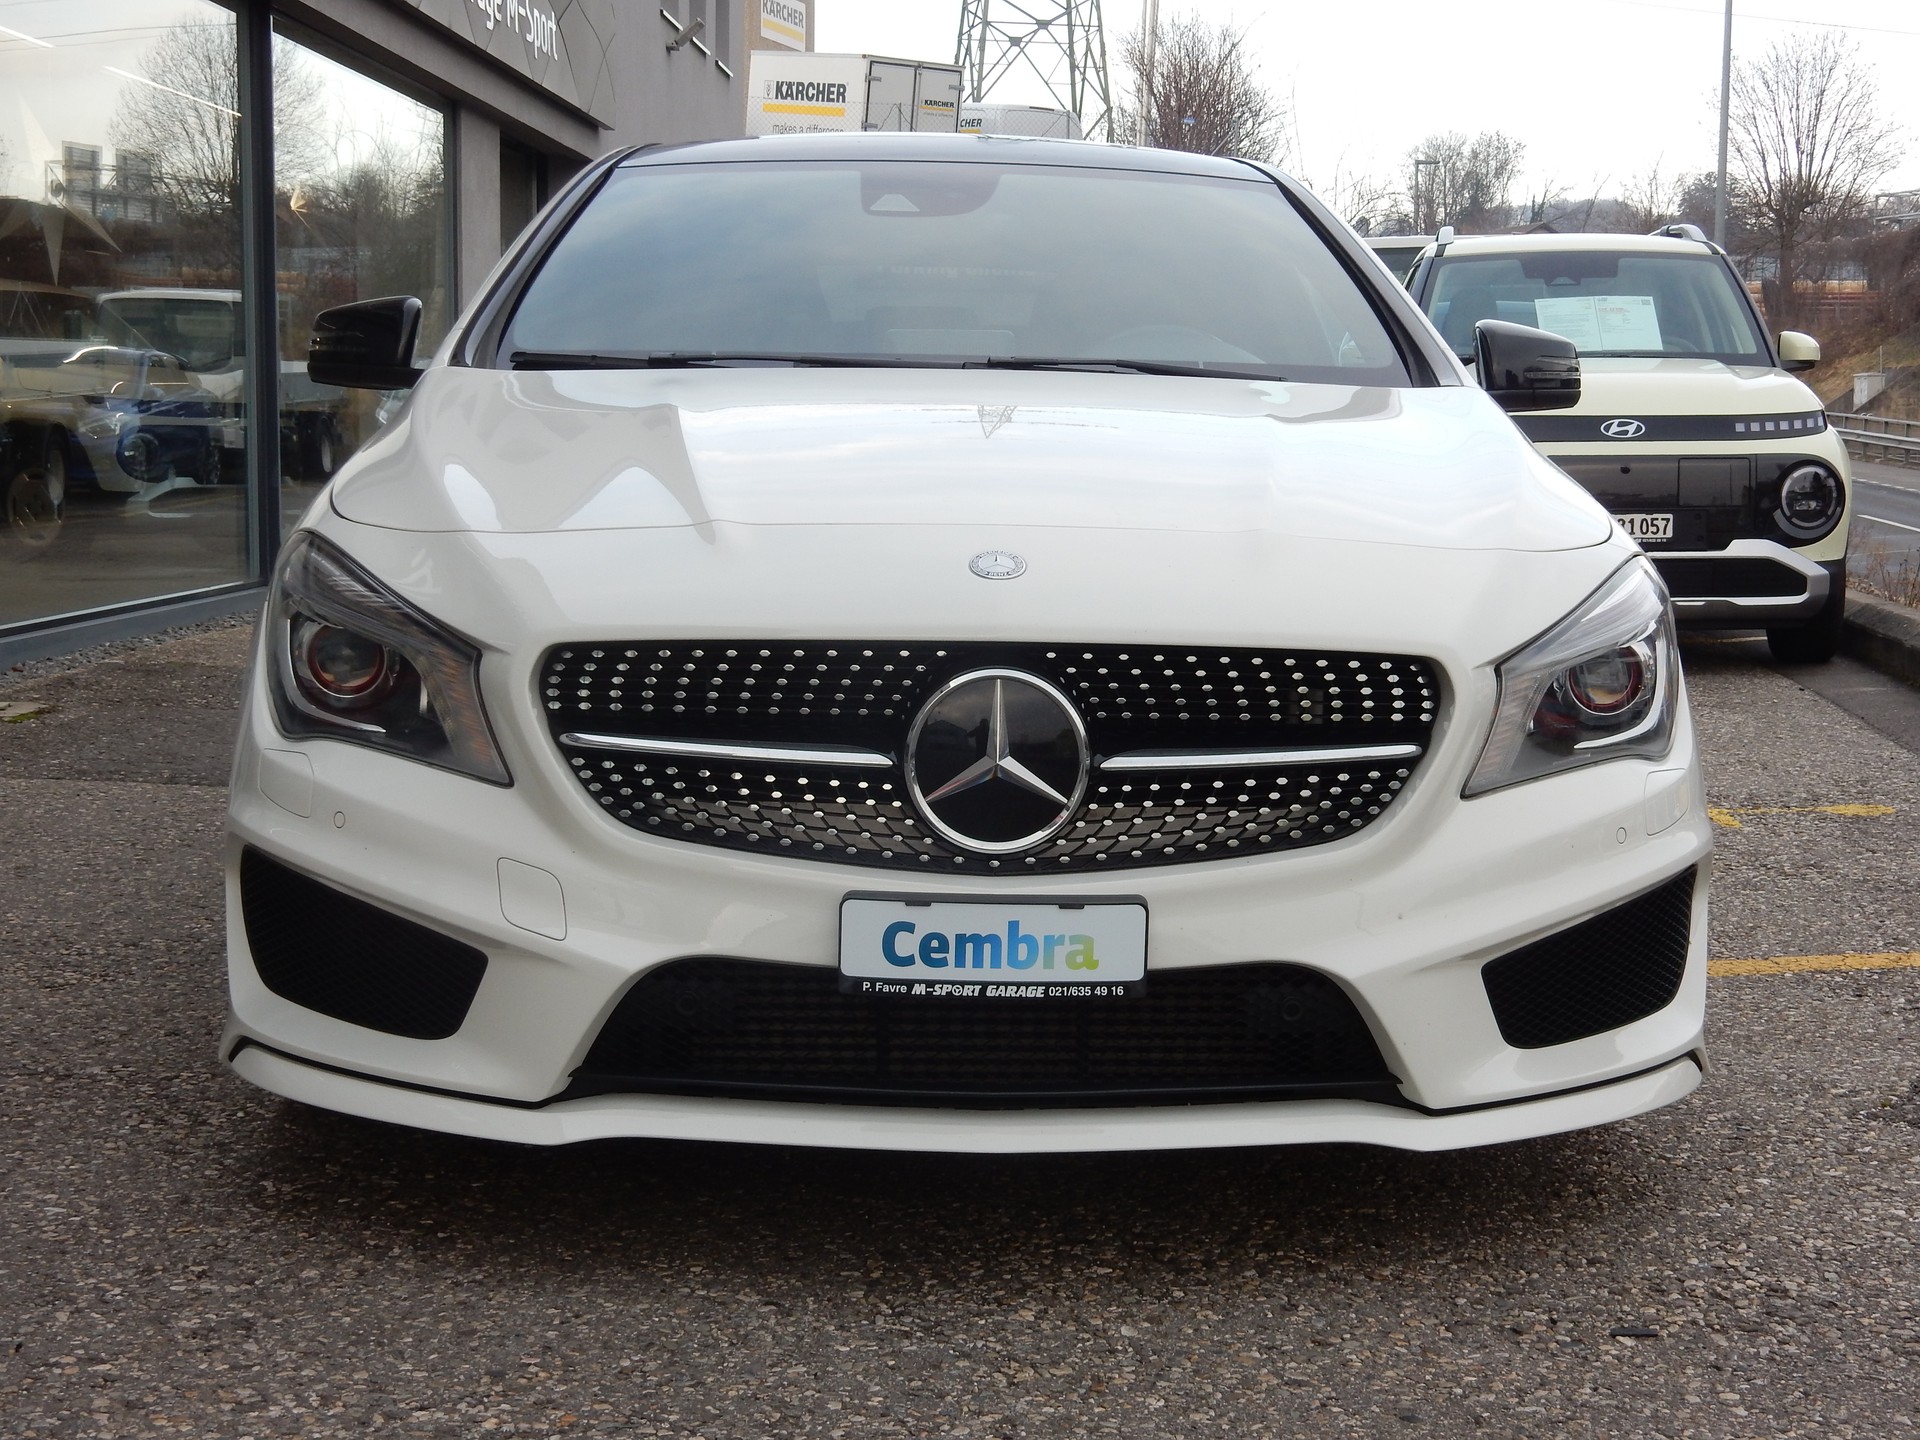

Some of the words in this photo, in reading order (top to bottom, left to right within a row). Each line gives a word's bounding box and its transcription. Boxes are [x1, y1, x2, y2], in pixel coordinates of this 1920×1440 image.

[762, 0, 804, 28] KÄRCHER
[507, 0, 557, 60] M-Sport
[775, 81, 847, 103] KÄRCHER
[773, 122, 797, 134] makes
[882, 919, 1099, 971] Cembra
[863, 982, 872, 992] P.
[875, 982, 908, 993] Favre
[911, 983, 982, 996] M-SPORT
[986, 985, 1045, 997] GARAGE
[1048, 986, 1091, 996] 021/635
[1094, 986, 1108, 996] 49
[1111, 986, 1124, 996] 16
